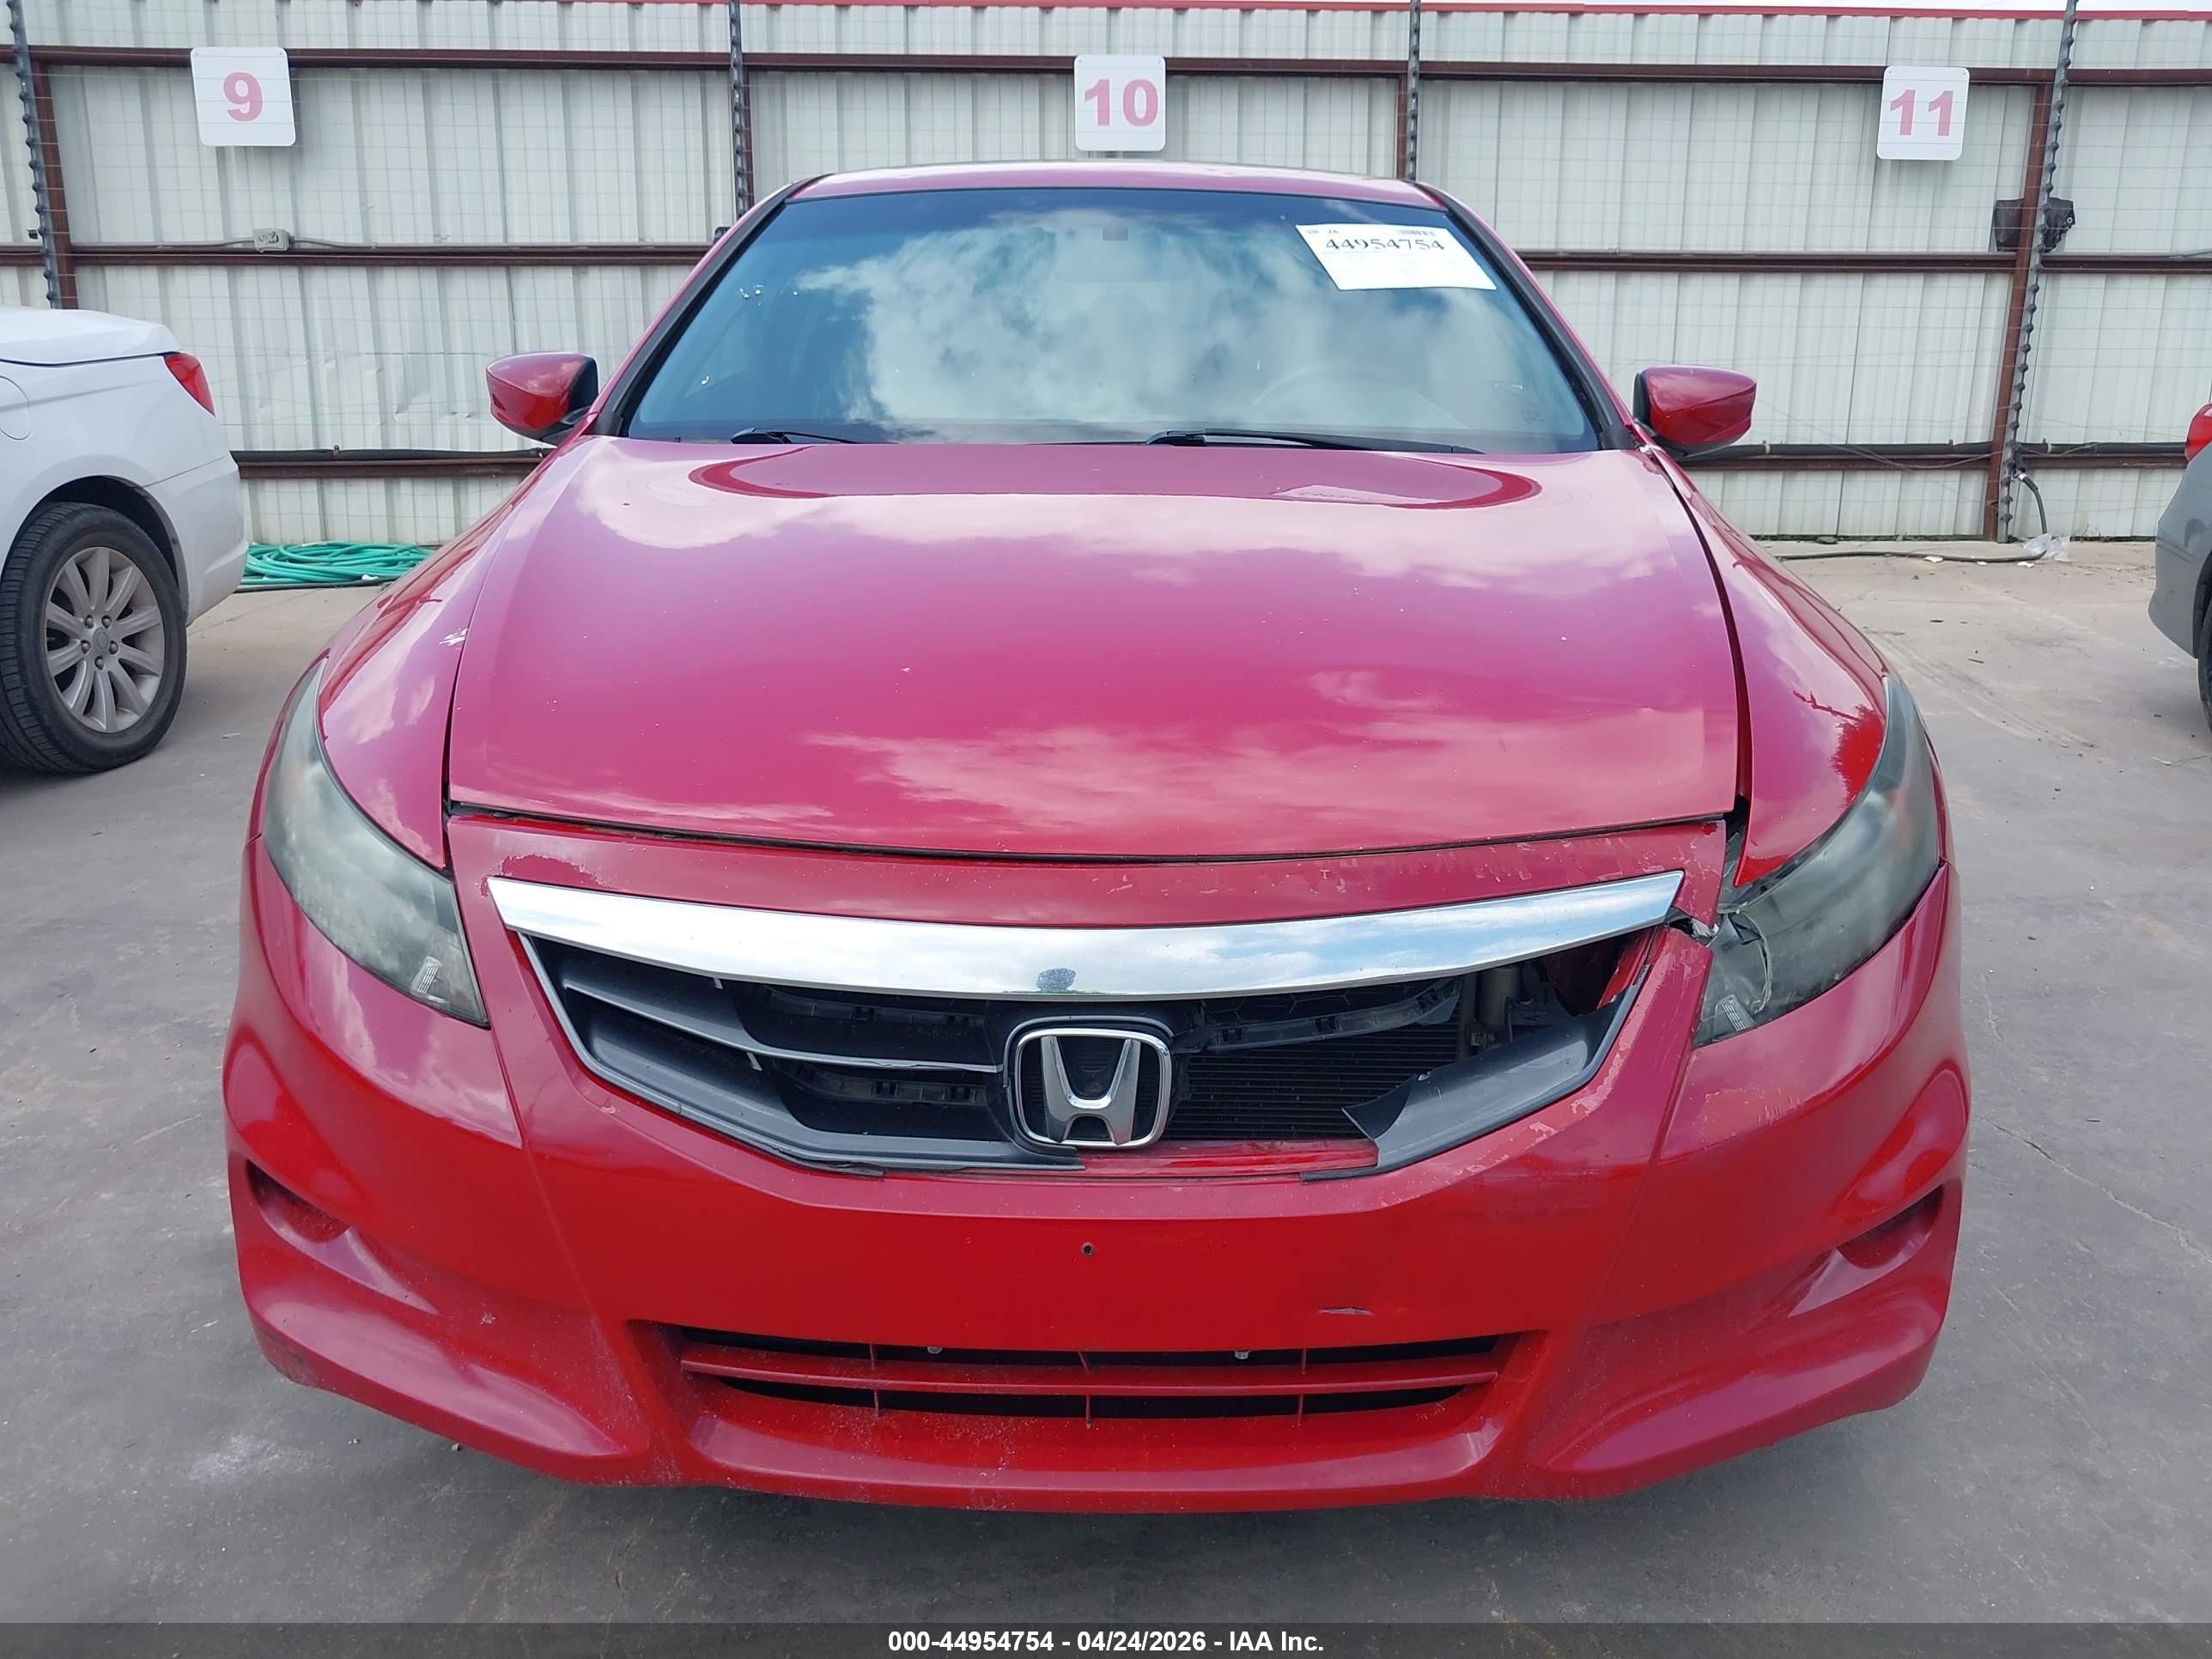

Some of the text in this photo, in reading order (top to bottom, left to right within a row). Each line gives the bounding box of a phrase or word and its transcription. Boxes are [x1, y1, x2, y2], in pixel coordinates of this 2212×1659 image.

[222, 72, 263, 121] 9
[1085, 79, 1158, 126] 10
[1890, 89, 1954, 137] 11
[1326, 239, 1444, 250] 44954754
